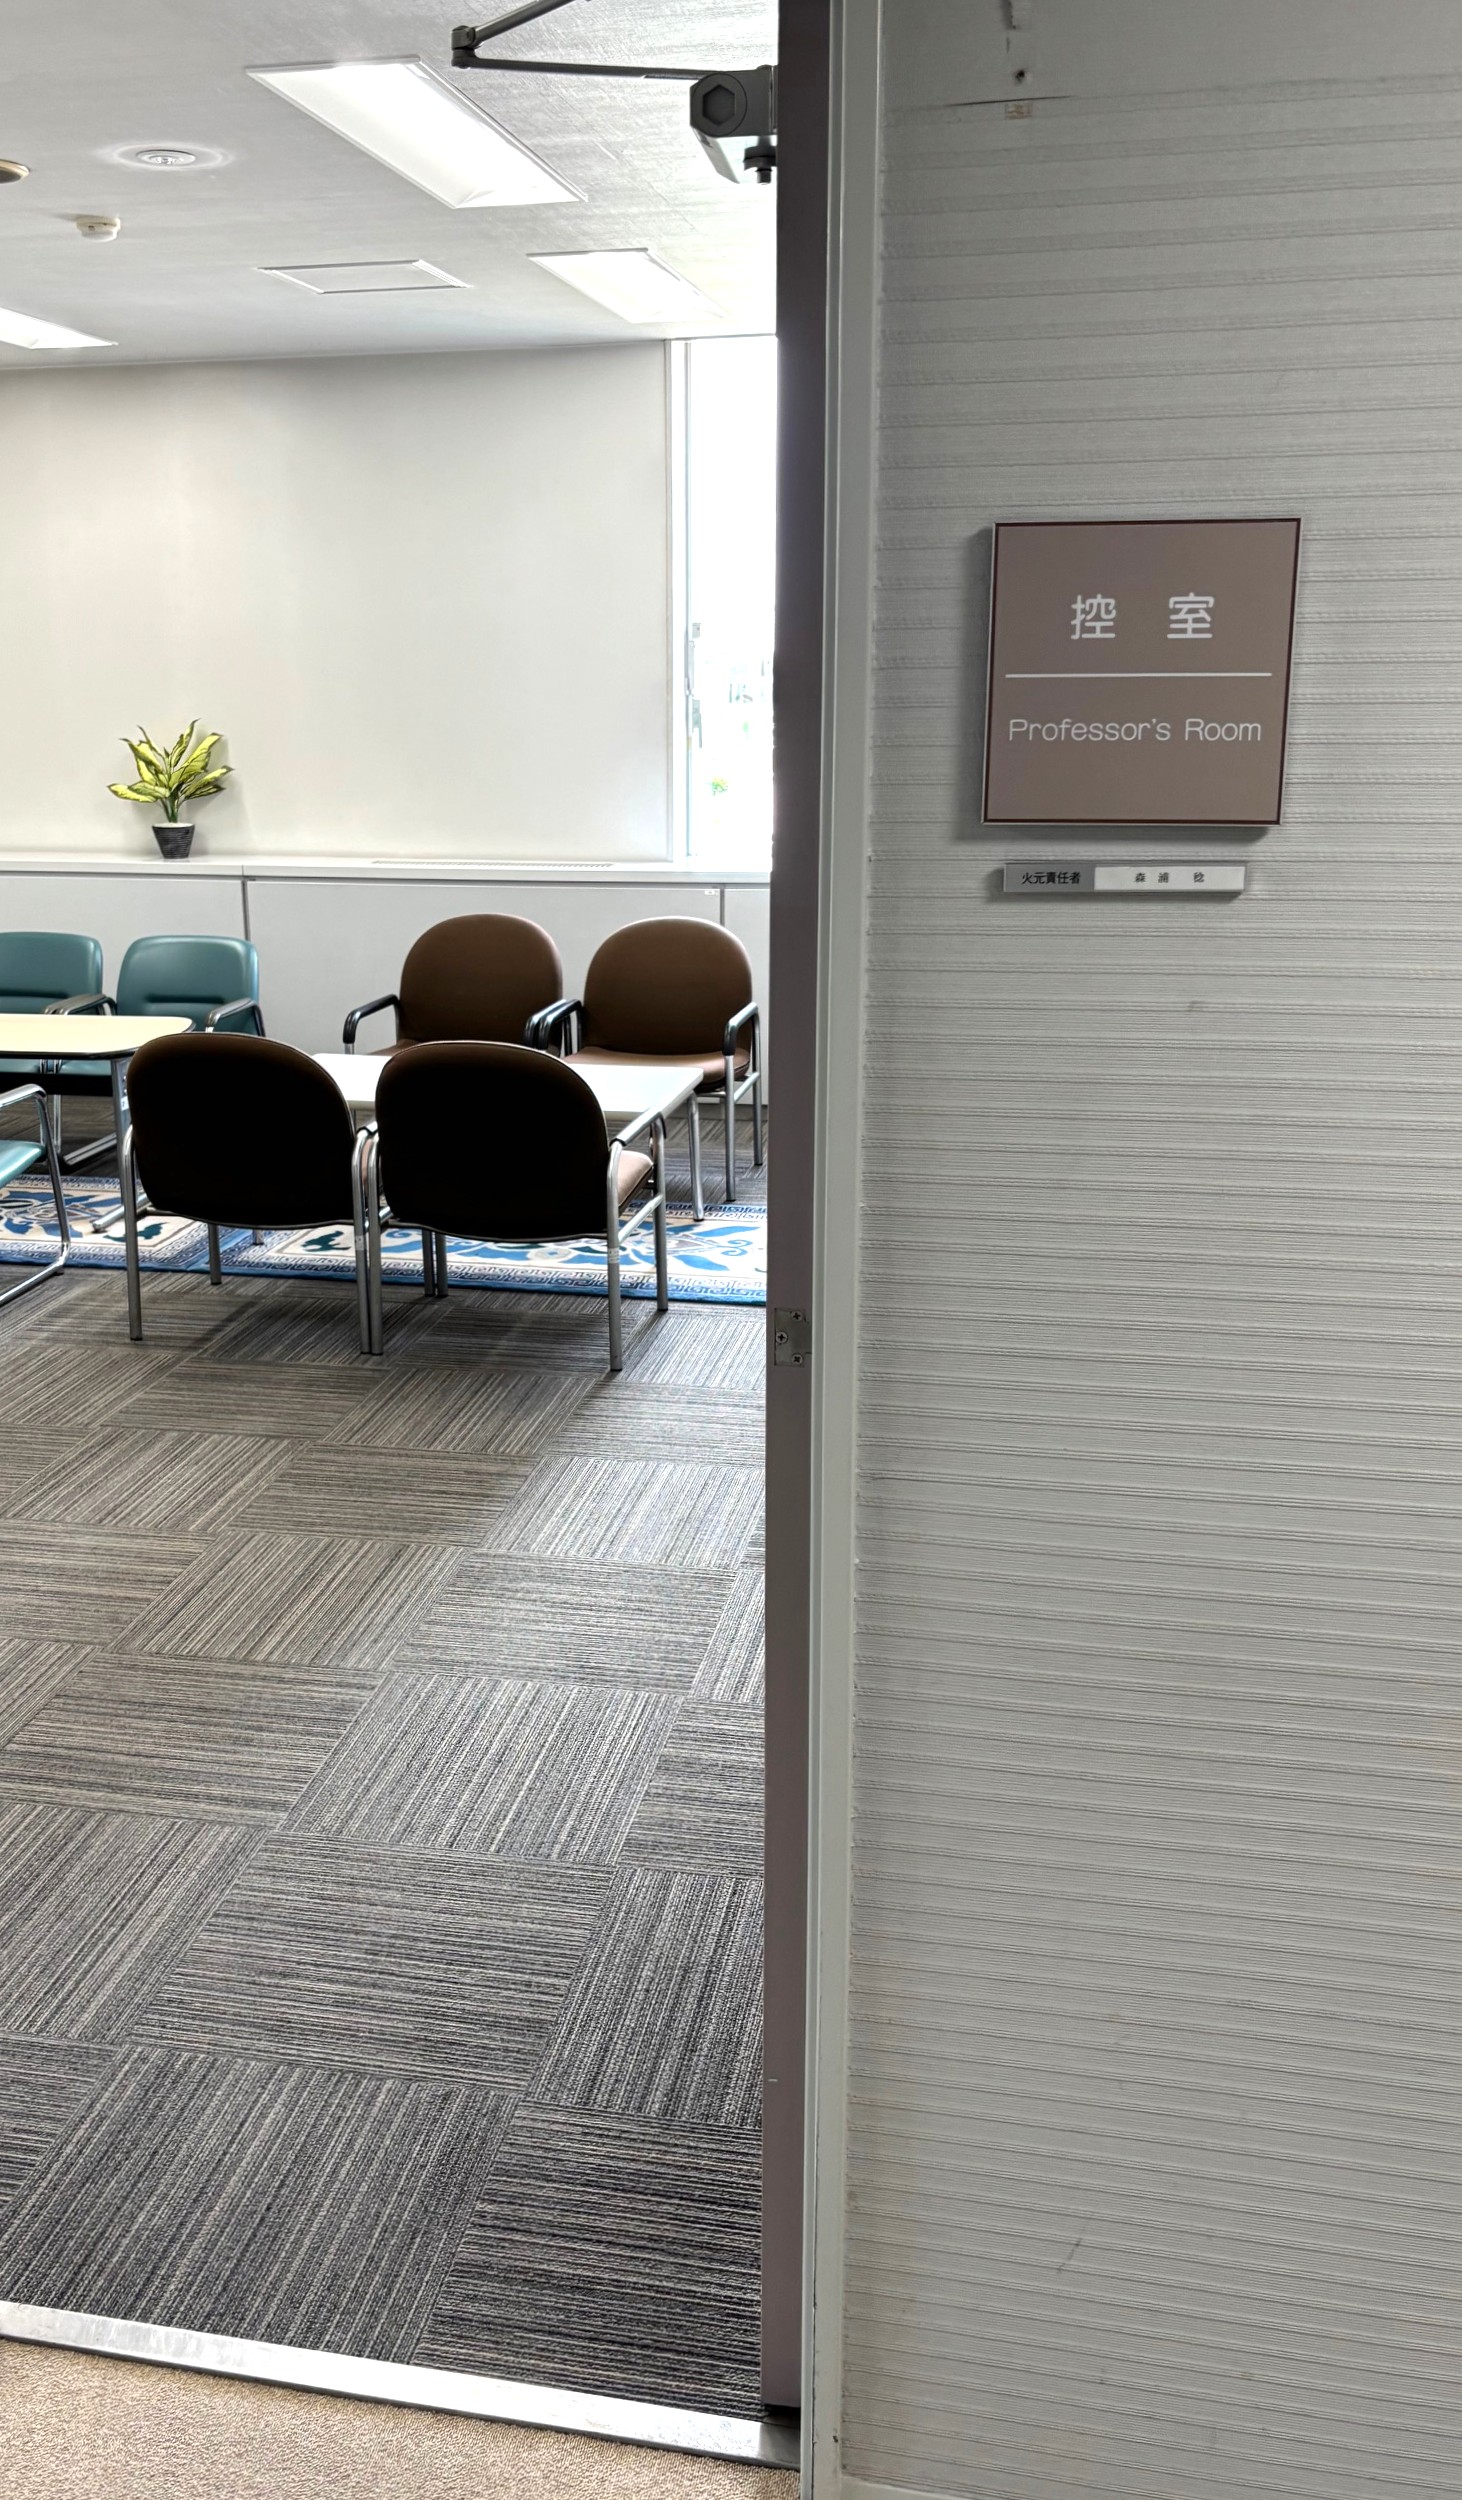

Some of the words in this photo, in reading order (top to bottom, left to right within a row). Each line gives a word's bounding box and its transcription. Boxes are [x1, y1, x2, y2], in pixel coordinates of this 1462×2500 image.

[1070, 592, 1215, 640] 控室
[1008, 718, 1172, 742] Professor's
[1184, 718, 1262, 742] Room
[1021, 871, 1081, 885] 火元責任者
